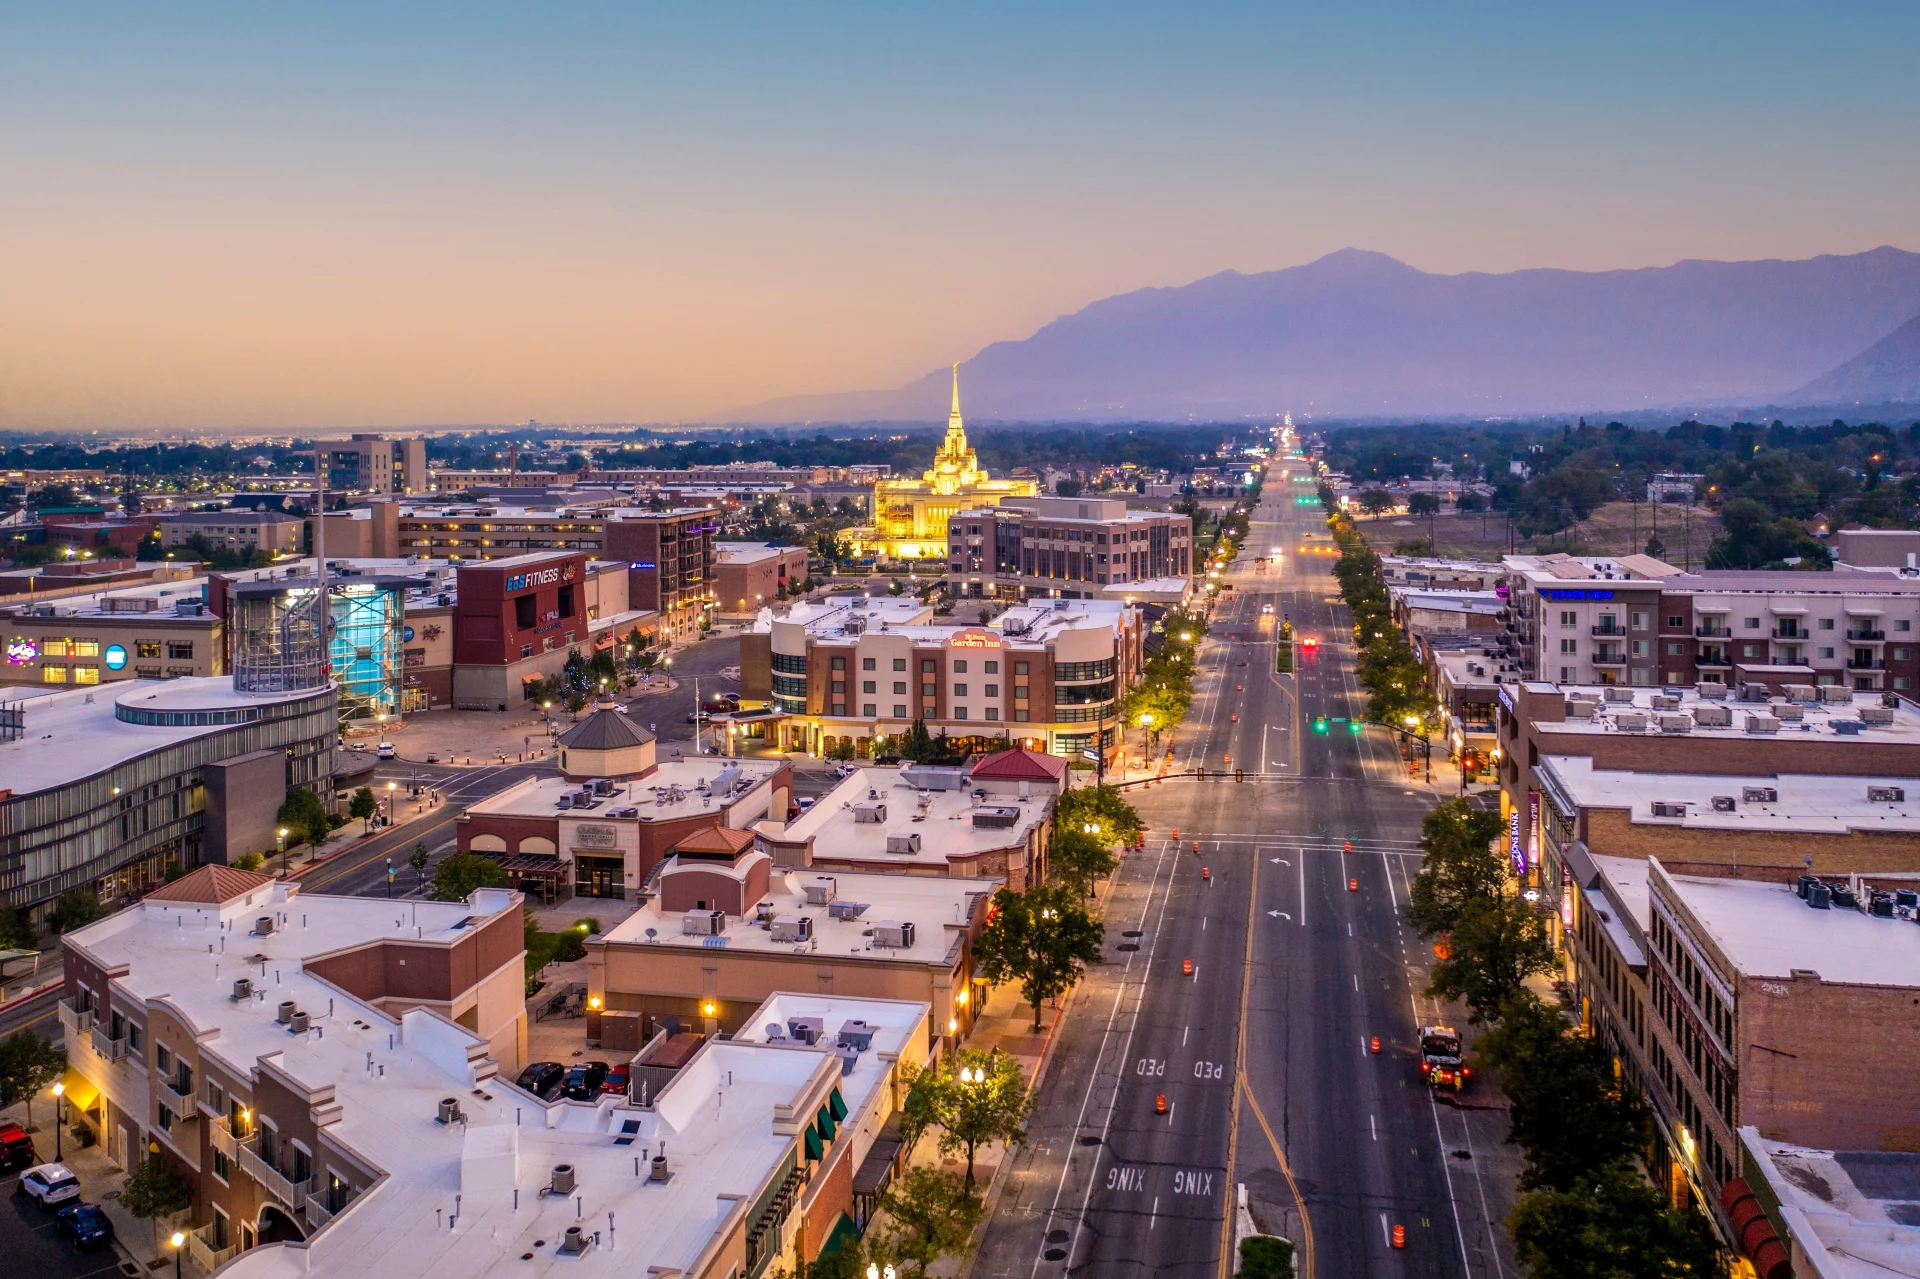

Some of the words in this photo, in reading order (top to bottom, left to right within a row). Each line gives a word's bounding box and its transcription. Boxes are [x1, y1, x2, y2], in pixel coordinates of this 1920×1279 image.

[524, 567, 558, 588] FITNESS
[1551, 590, 1587, 600] TOWER
[1588, 590, 1614, 600] VIEW
[950, 639, 983, 648] Garden
[984, 640, 1001, 648] Inn
[1511, 813, 1519, 835] BANK
[1511, 837, 1519, 859] ZIONS
[1137, 1059, 1166, 1076] PED
[1194, 1061, 1222, 1079] PED
[1107, 1167, 1146, 1192] XING
[1174, 1170, 1212, 1195] XING
